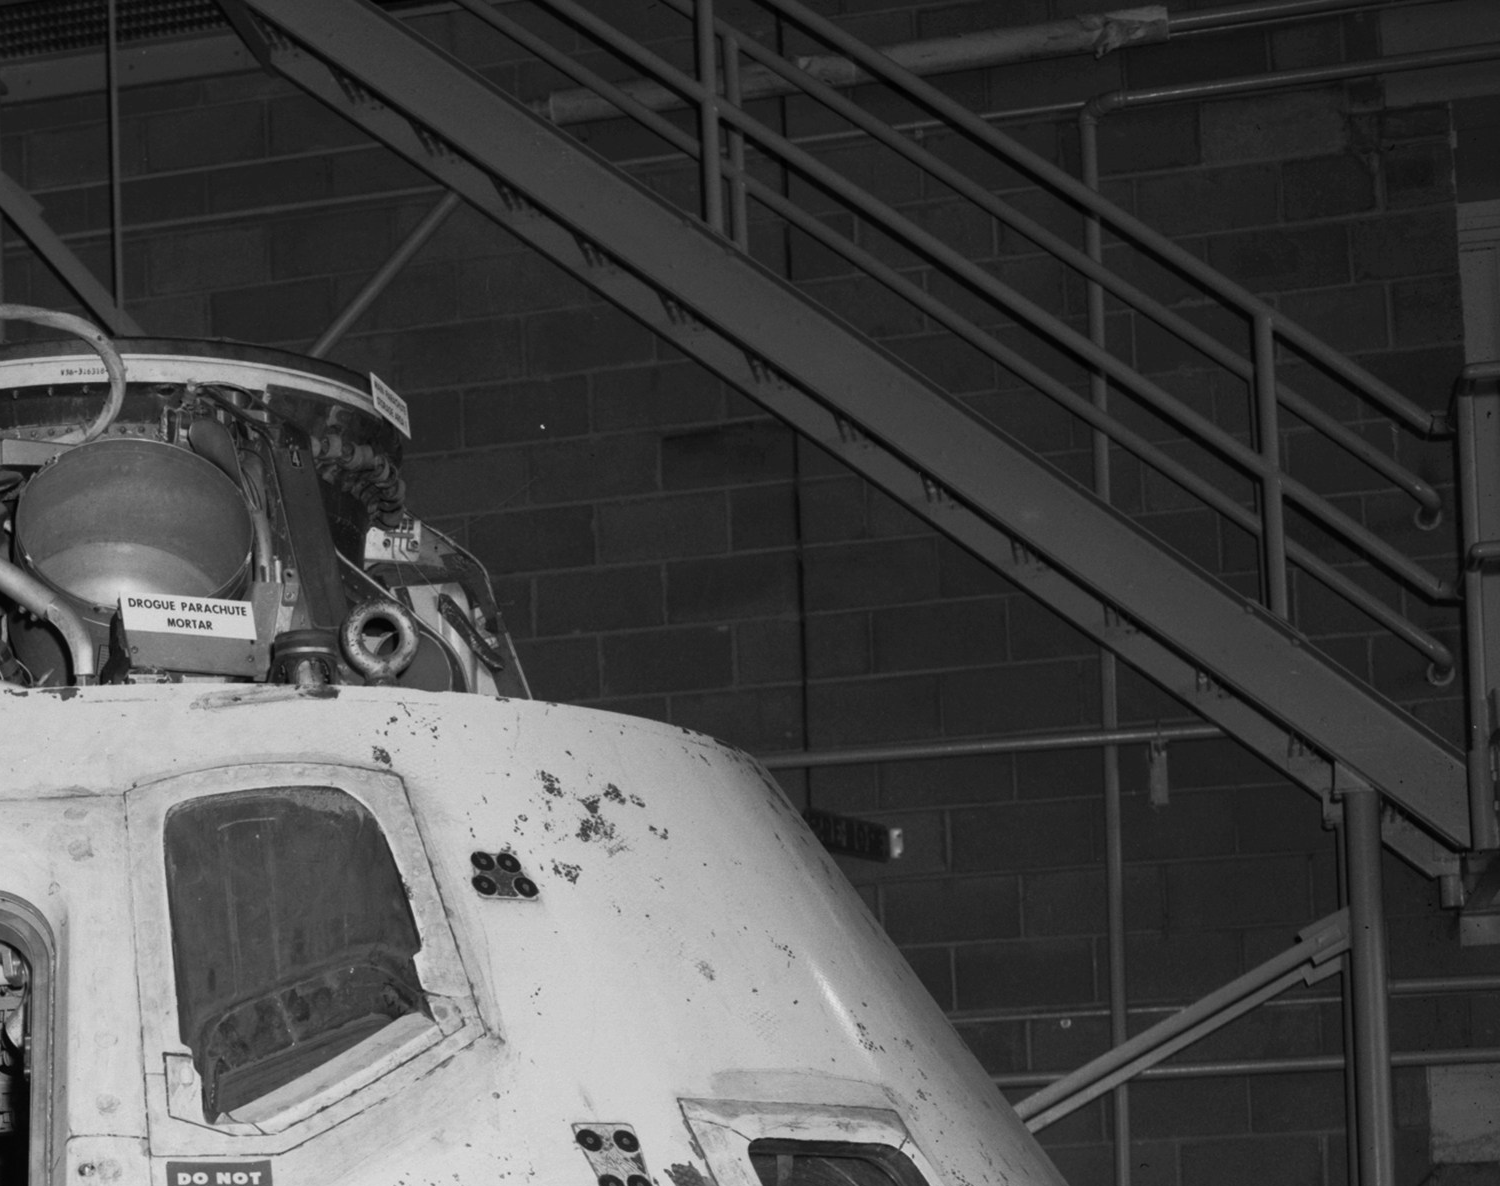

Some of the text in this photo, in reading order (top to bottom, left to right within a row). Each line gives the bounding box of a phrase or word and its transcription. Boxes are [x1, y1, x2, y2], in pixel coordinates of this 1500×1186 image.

[127, 597, 247, 616] DROGUE PARACHUTE
[167, 617, 213, 630] MORTAR
[177, 1171, 262, 1186] DO NOT
